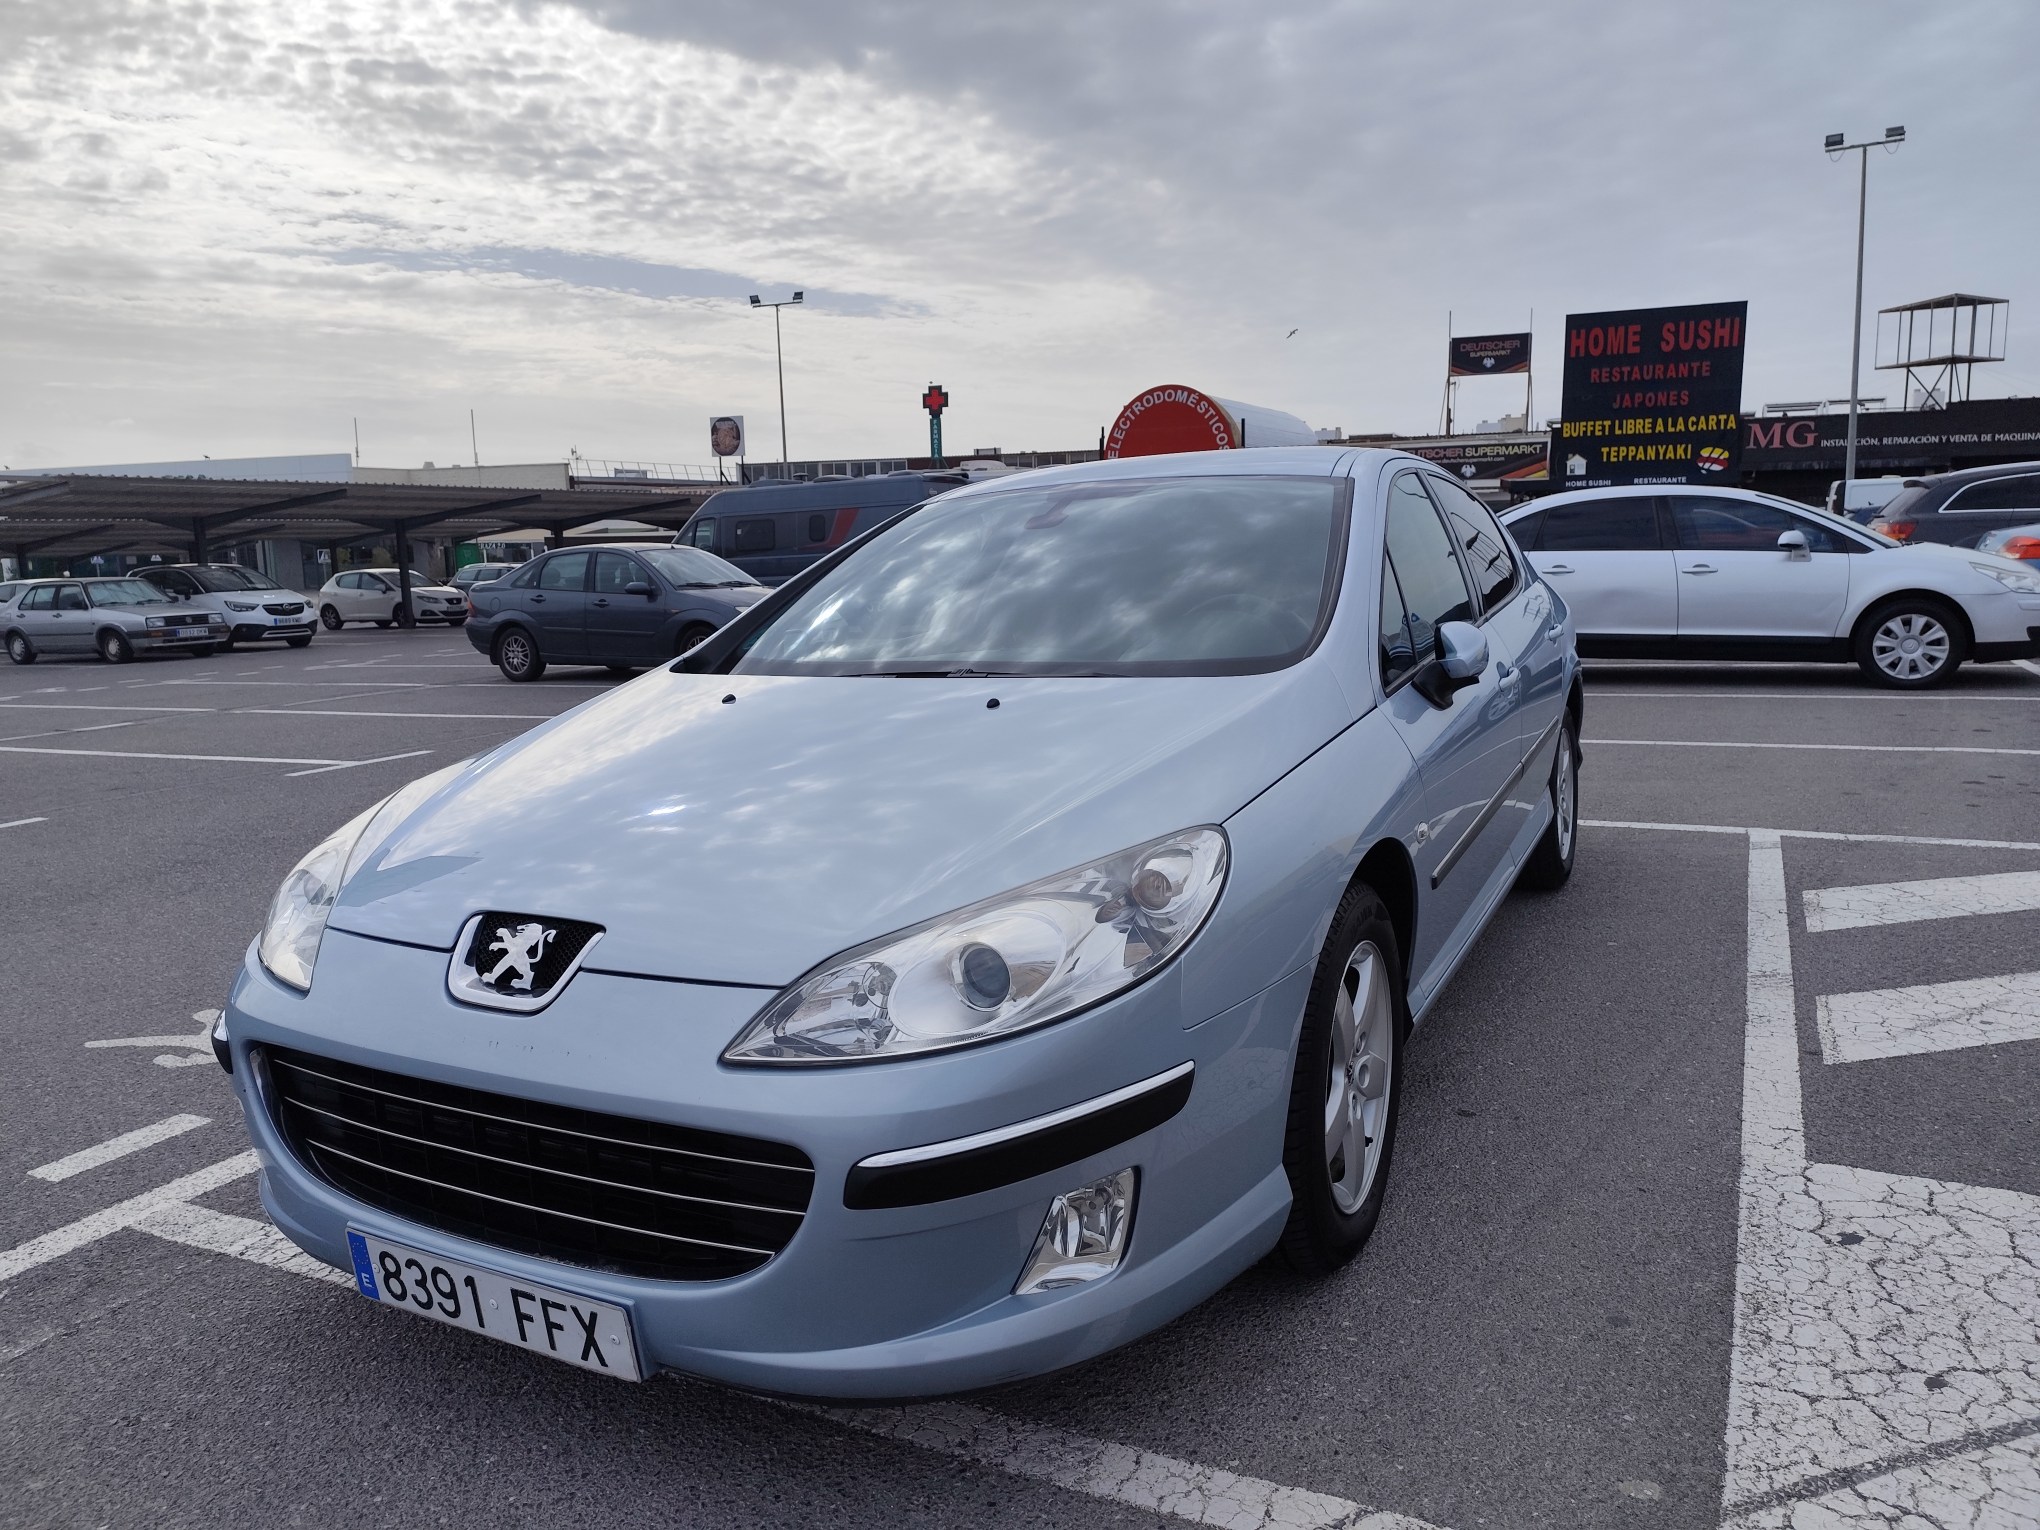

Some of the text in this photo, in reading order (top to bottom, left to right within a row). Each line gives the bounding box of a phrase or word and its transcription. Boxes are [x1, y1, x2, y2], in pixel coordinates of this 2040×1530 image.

[1460, 340, 1520, 351] DEUTSCHER
[1569, 317, 1740, 358] HOME SUSHI
[1469, 349, 1511, 357] SUPERMARKT
[1590, 361, 1711, 383] RESTAURANTE
[1612, 390, 1690, 409] JAPONES
[1562, 413, 1737, 438] BUFFET LIBRE A LA CARTA
[1745, 420, 1819, 449] MG
[1820, 437, 1880, 448] INSTALCIÓN,
[1882, 434, 1939, 446] REPARACIÓN
[1941, 435, 1948, 443] Y
[1949, 434, 1979, 443] VENTA
[1980, 433, 1993, 442] DE
[1465, 444, 1543, 456] SUPERMARKT
[1601, 443, 1692, 463] TEPPANYAKI
[1565, 479, 1612, 488] HOME SUSHI
[1633, 476, 1687, 485] RESTAURANTE
[361, 1272, 373, 1288] E
[379, 1251, 608, 1367] 8391 FFX
